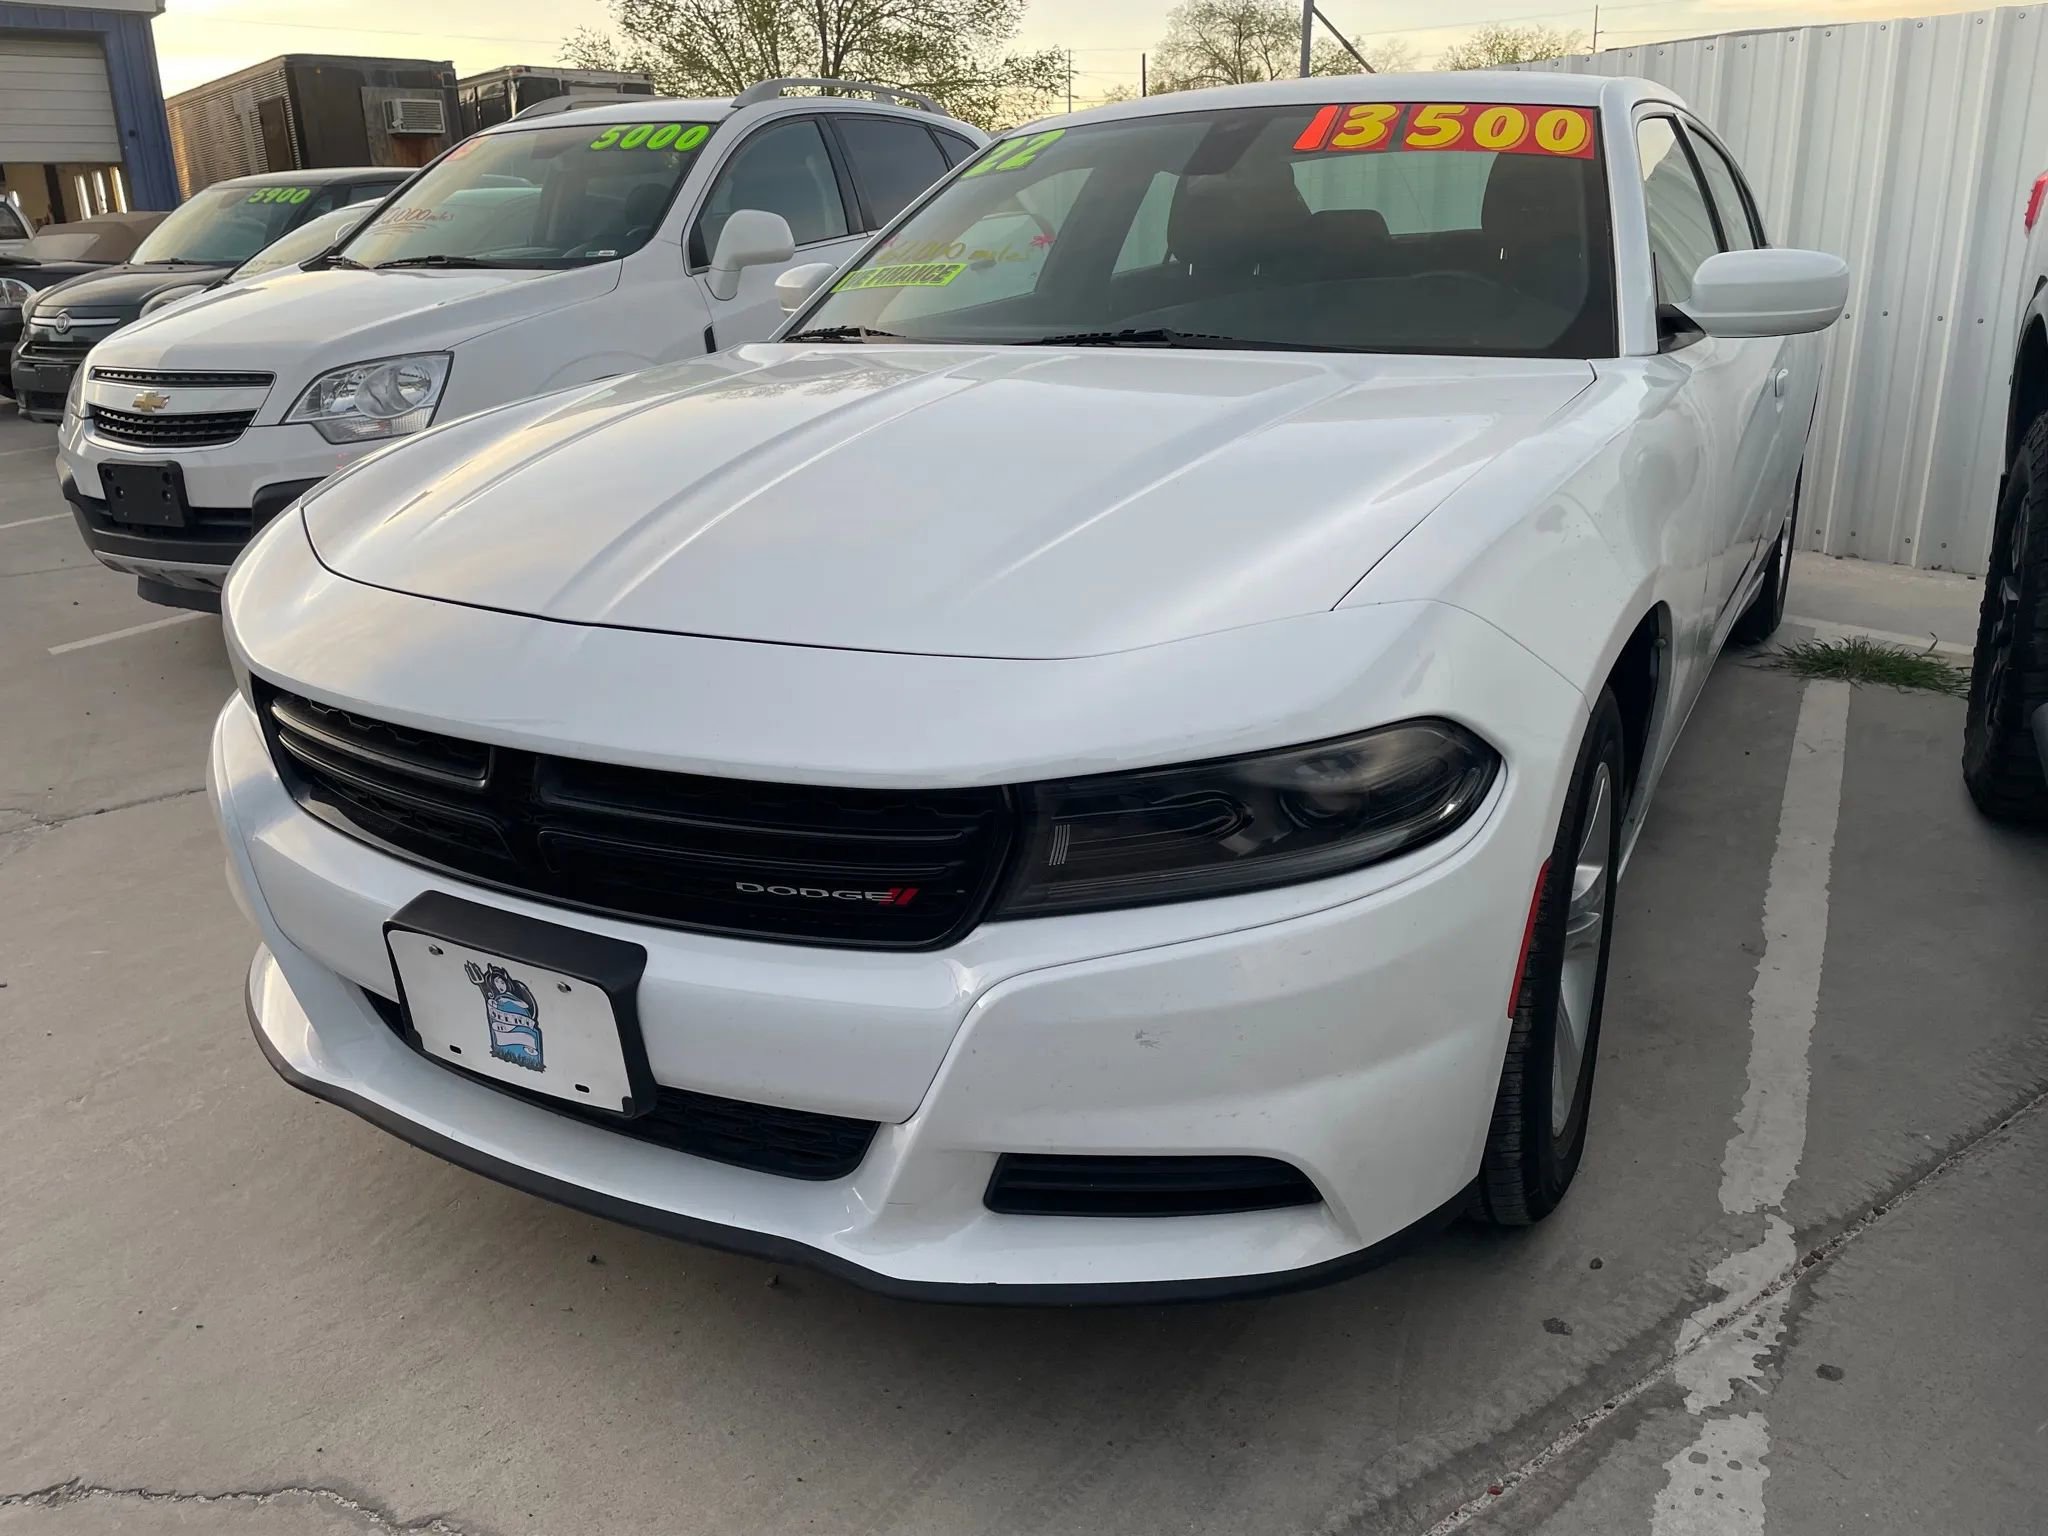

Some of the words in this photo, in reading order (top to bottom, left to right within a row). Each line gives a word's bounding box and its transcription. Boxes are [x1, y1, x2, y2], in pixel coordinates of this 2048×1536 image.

[590, 124, 711, 151] 5000
[1292, 103, 1591, 154] 13500
[247, 186, 312, 205] 5900
[866, 264, 962, 286] FINANCE
[735, 881, 895, 902] DODGE
